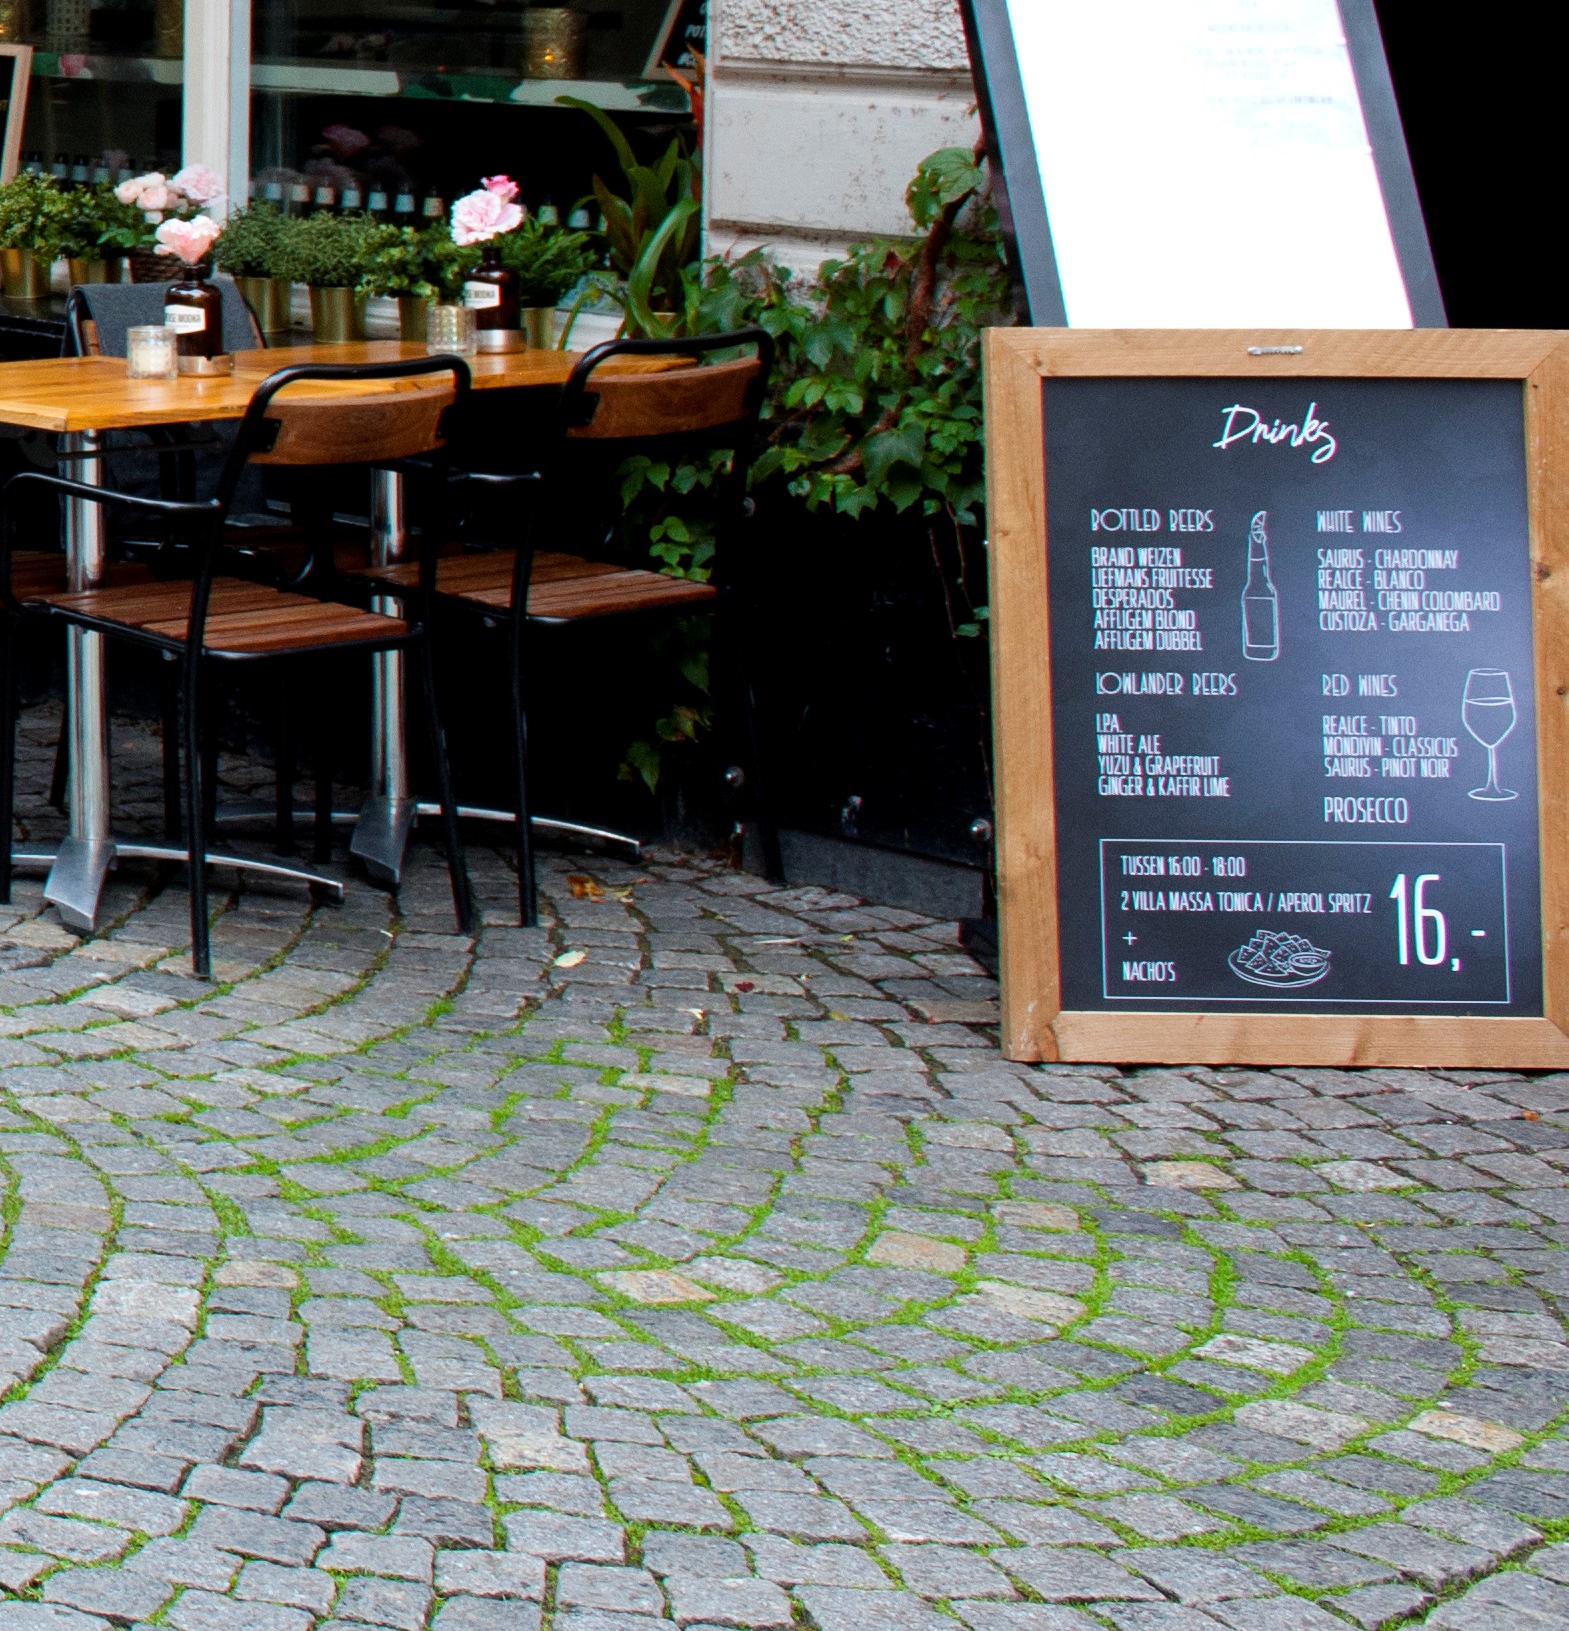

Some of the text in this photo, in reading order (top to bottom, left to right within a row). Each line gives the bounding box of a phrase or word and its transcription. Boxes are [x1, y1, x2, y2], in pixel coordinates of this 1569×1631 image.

[1213, 402, 1337, 463] Drinks
[1091, 509, 1214, 532] BOTTLED BEERS
[1317, 510, 1401, 533] WHITE WINES
[1091, 547, 1181, 567] BRAND WEIZEN
[1318, 549, 1457, 569] SAURUS CHARDONNAY
[1092, 566, 1212, 590] LIEFMANS FRUITESSE
[1318, 568, 1424, 589] REALCE BLANCO
[1093, 586, 1174, 610] DESPERADOS
[1319, 588, 1500, 613] MAUREL CHENIN COLOMBARD
[1094, 609, 1195, 631] AFFLIGEM BLOND
[1320, 610, 1469, 631] CUSTOZA GARGANEGA
[1095, 628, 1202, 650] AFFLIGEM DUBBEL
[1096, 672, 1237, 695] LOWLANDER BEERS
[1323, 674, 1397, 696] RED WINES
[1323, 716, 1416, 735] REALCE TINTO
[1097, 734, 1160, 754] WHITE ALE
[1324, 737, 1457, 758] MONDIVIN CLASSICUS
[1098, 755, 1134, 778] YUZU
[1146, 755, 1220, 778] GRAPEFRUIT
[1325, 755, 1452, 777] SAURUS PINOT NOIR
[1099, 776, 1143, 796] GINGER
[1153, 777, 1201, 796] KAFFIR
[1199, 777, 1229, 796] LIME
[1325, 797, 1408, 823] PROSECCO
[1121, 856, 1245, 876] TUSSEN 16:00 18:00
[1121, 891, 1129, 910] 2
[1128, 891, 1166, 911] VILLA
[1165, 891, 1213, 911] MASSA
[1217, 892, 1263, 912] TONICA
[1278, 893, 1325, 913] APEROL
[1329, 893, 1371, 913] SPRITZ
[1123, 961, 1175, 981] NACHO'S
